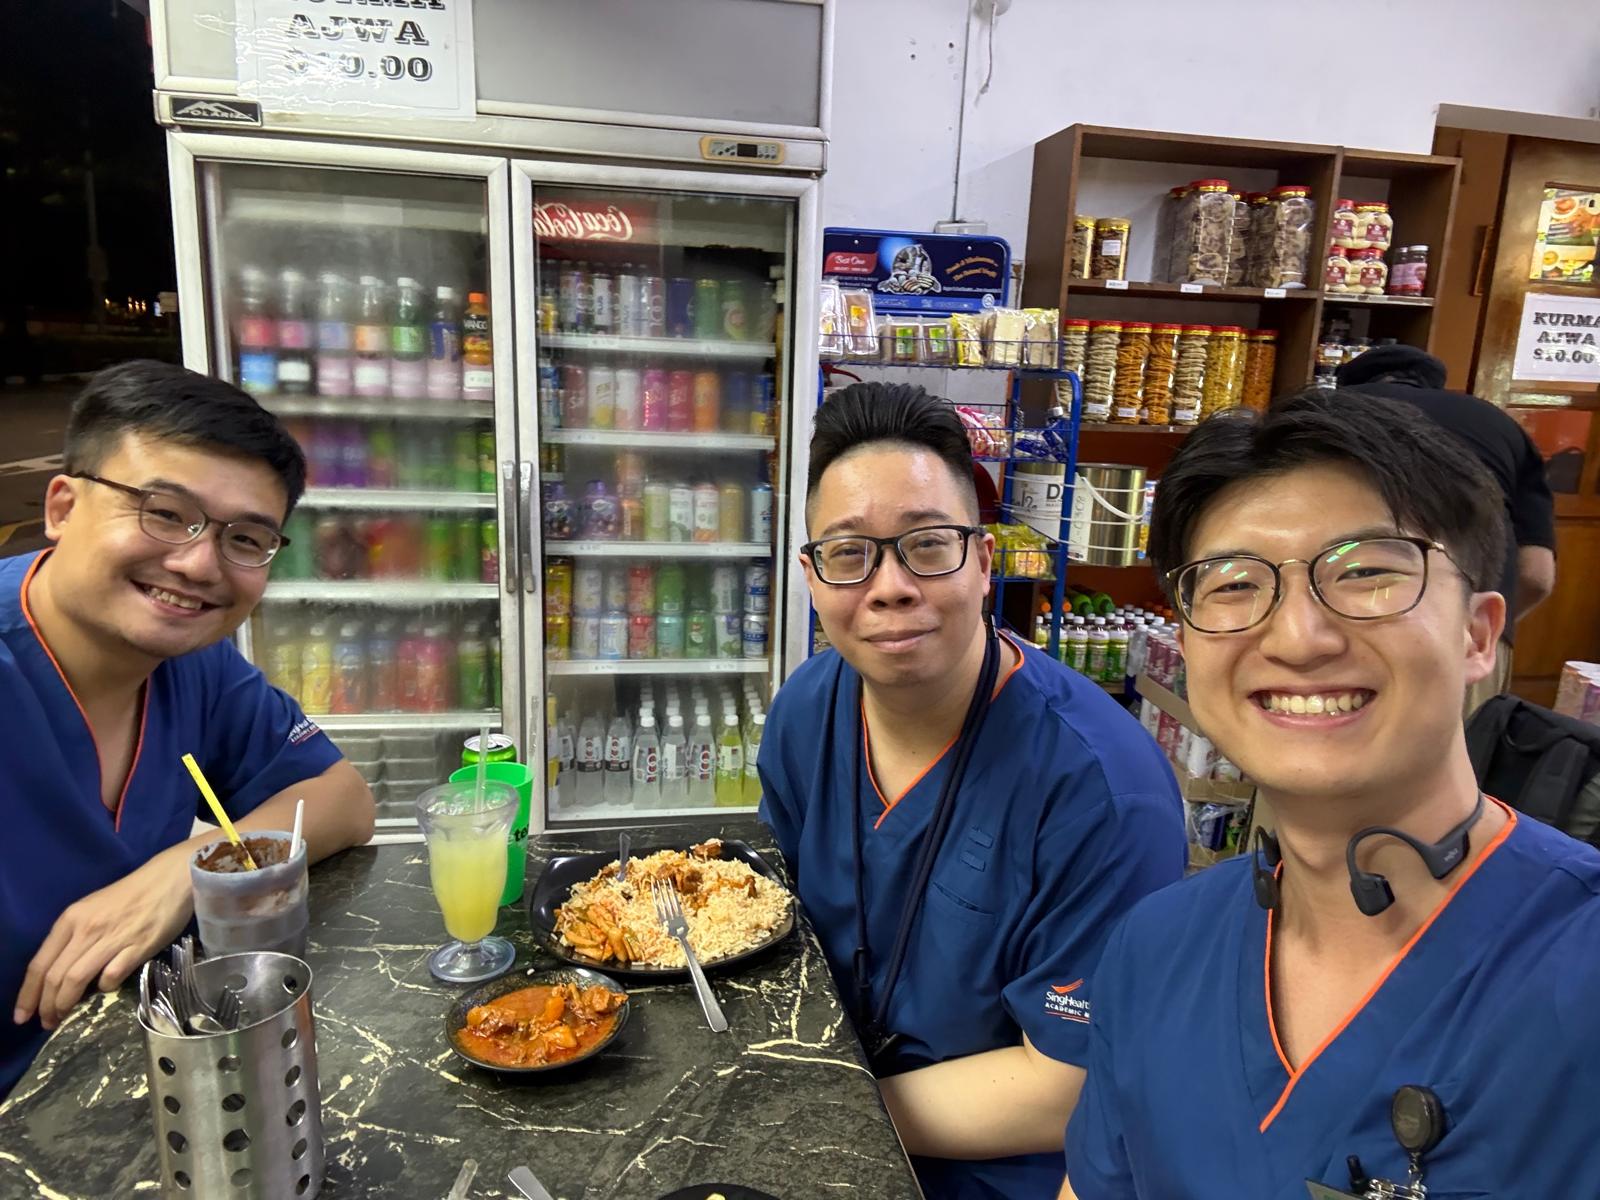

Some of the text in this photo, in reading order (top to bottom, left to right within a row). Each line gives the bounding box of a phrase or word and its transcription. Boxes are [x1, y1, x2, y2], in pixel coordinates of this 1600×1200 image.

[286, 14, 430, 46] AJWA
[1537, 331, 1596, 346] AJWA
[1045, 1002, 1082, 1016] ACADEMIC
